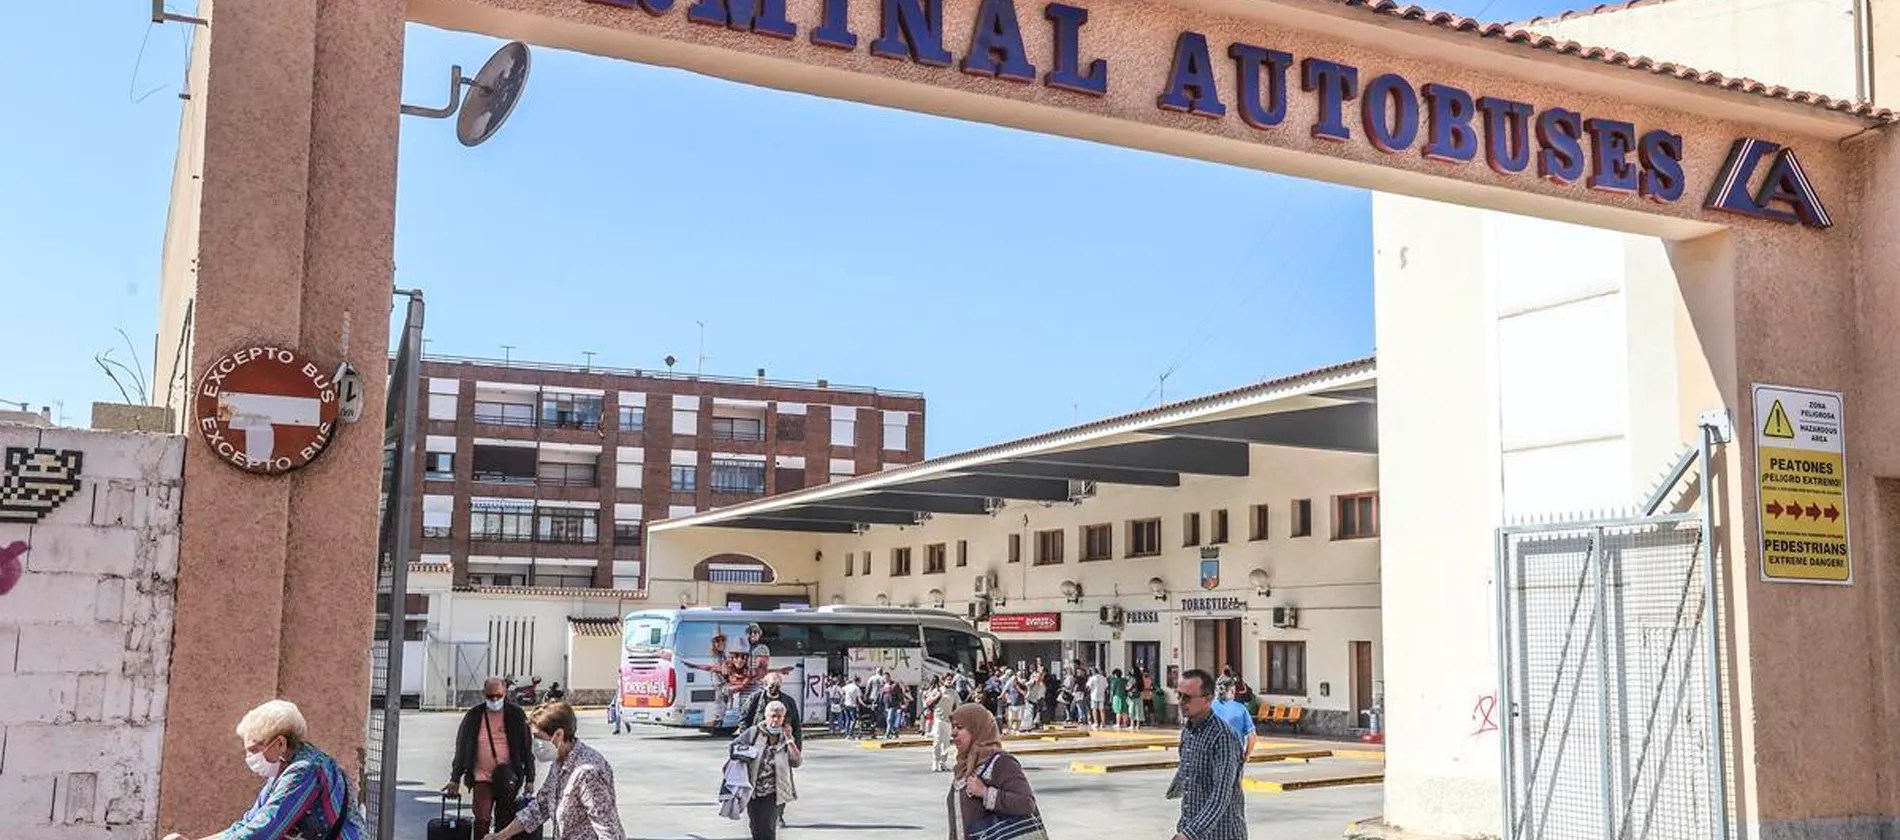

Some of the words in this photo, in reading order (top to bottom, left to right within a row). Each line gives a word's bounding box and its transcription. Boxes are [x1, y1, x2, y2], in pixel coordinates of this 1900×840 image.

[1157, 32, 1686, 203] AUTOBUSES
[204, 347, 294, 398] EXCEPTO
[302, 362, 335, 403] BUS
[1809, 401, 1826, 409] ZONA
[1801, 410, 1836, 420] PELIGROSA
[1800, 424, 1838, 435] HAZARDOUS
[202, 416, 292, 471] EXCEPTO
[1811, 435, 1828, 443] AREA
[1770, 458, 1833, 475] PEATONES
[1764, 539, 1847, 556] PEDESTRIANS
[1768, 555, 1807, 566] EXTREME
[1126, 611, 1159, 624] PRENSA
